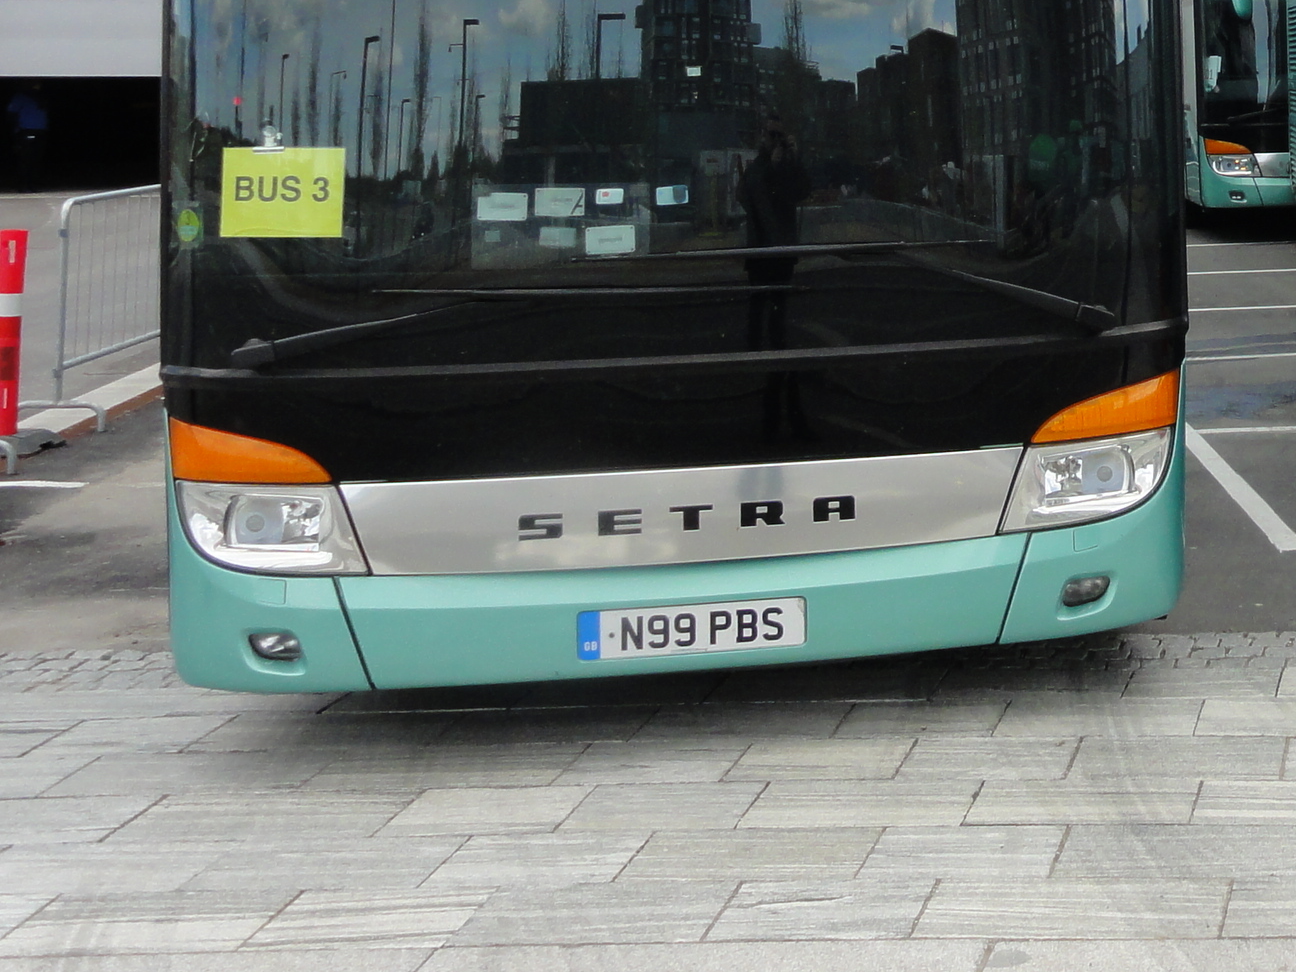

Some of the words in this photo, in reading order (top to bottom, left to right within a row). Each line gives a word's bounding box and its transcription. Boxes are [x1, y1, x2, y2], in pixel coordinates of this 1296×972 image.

[233, 175, 303, 203] BUS
[311, 175, 331, 202] 3
[518, 495, 856, 541] SETRA
[583, 641, 598, 652] GB
[620, 613, 698, 651] N99
[709, 607, 785, 645] PBS
